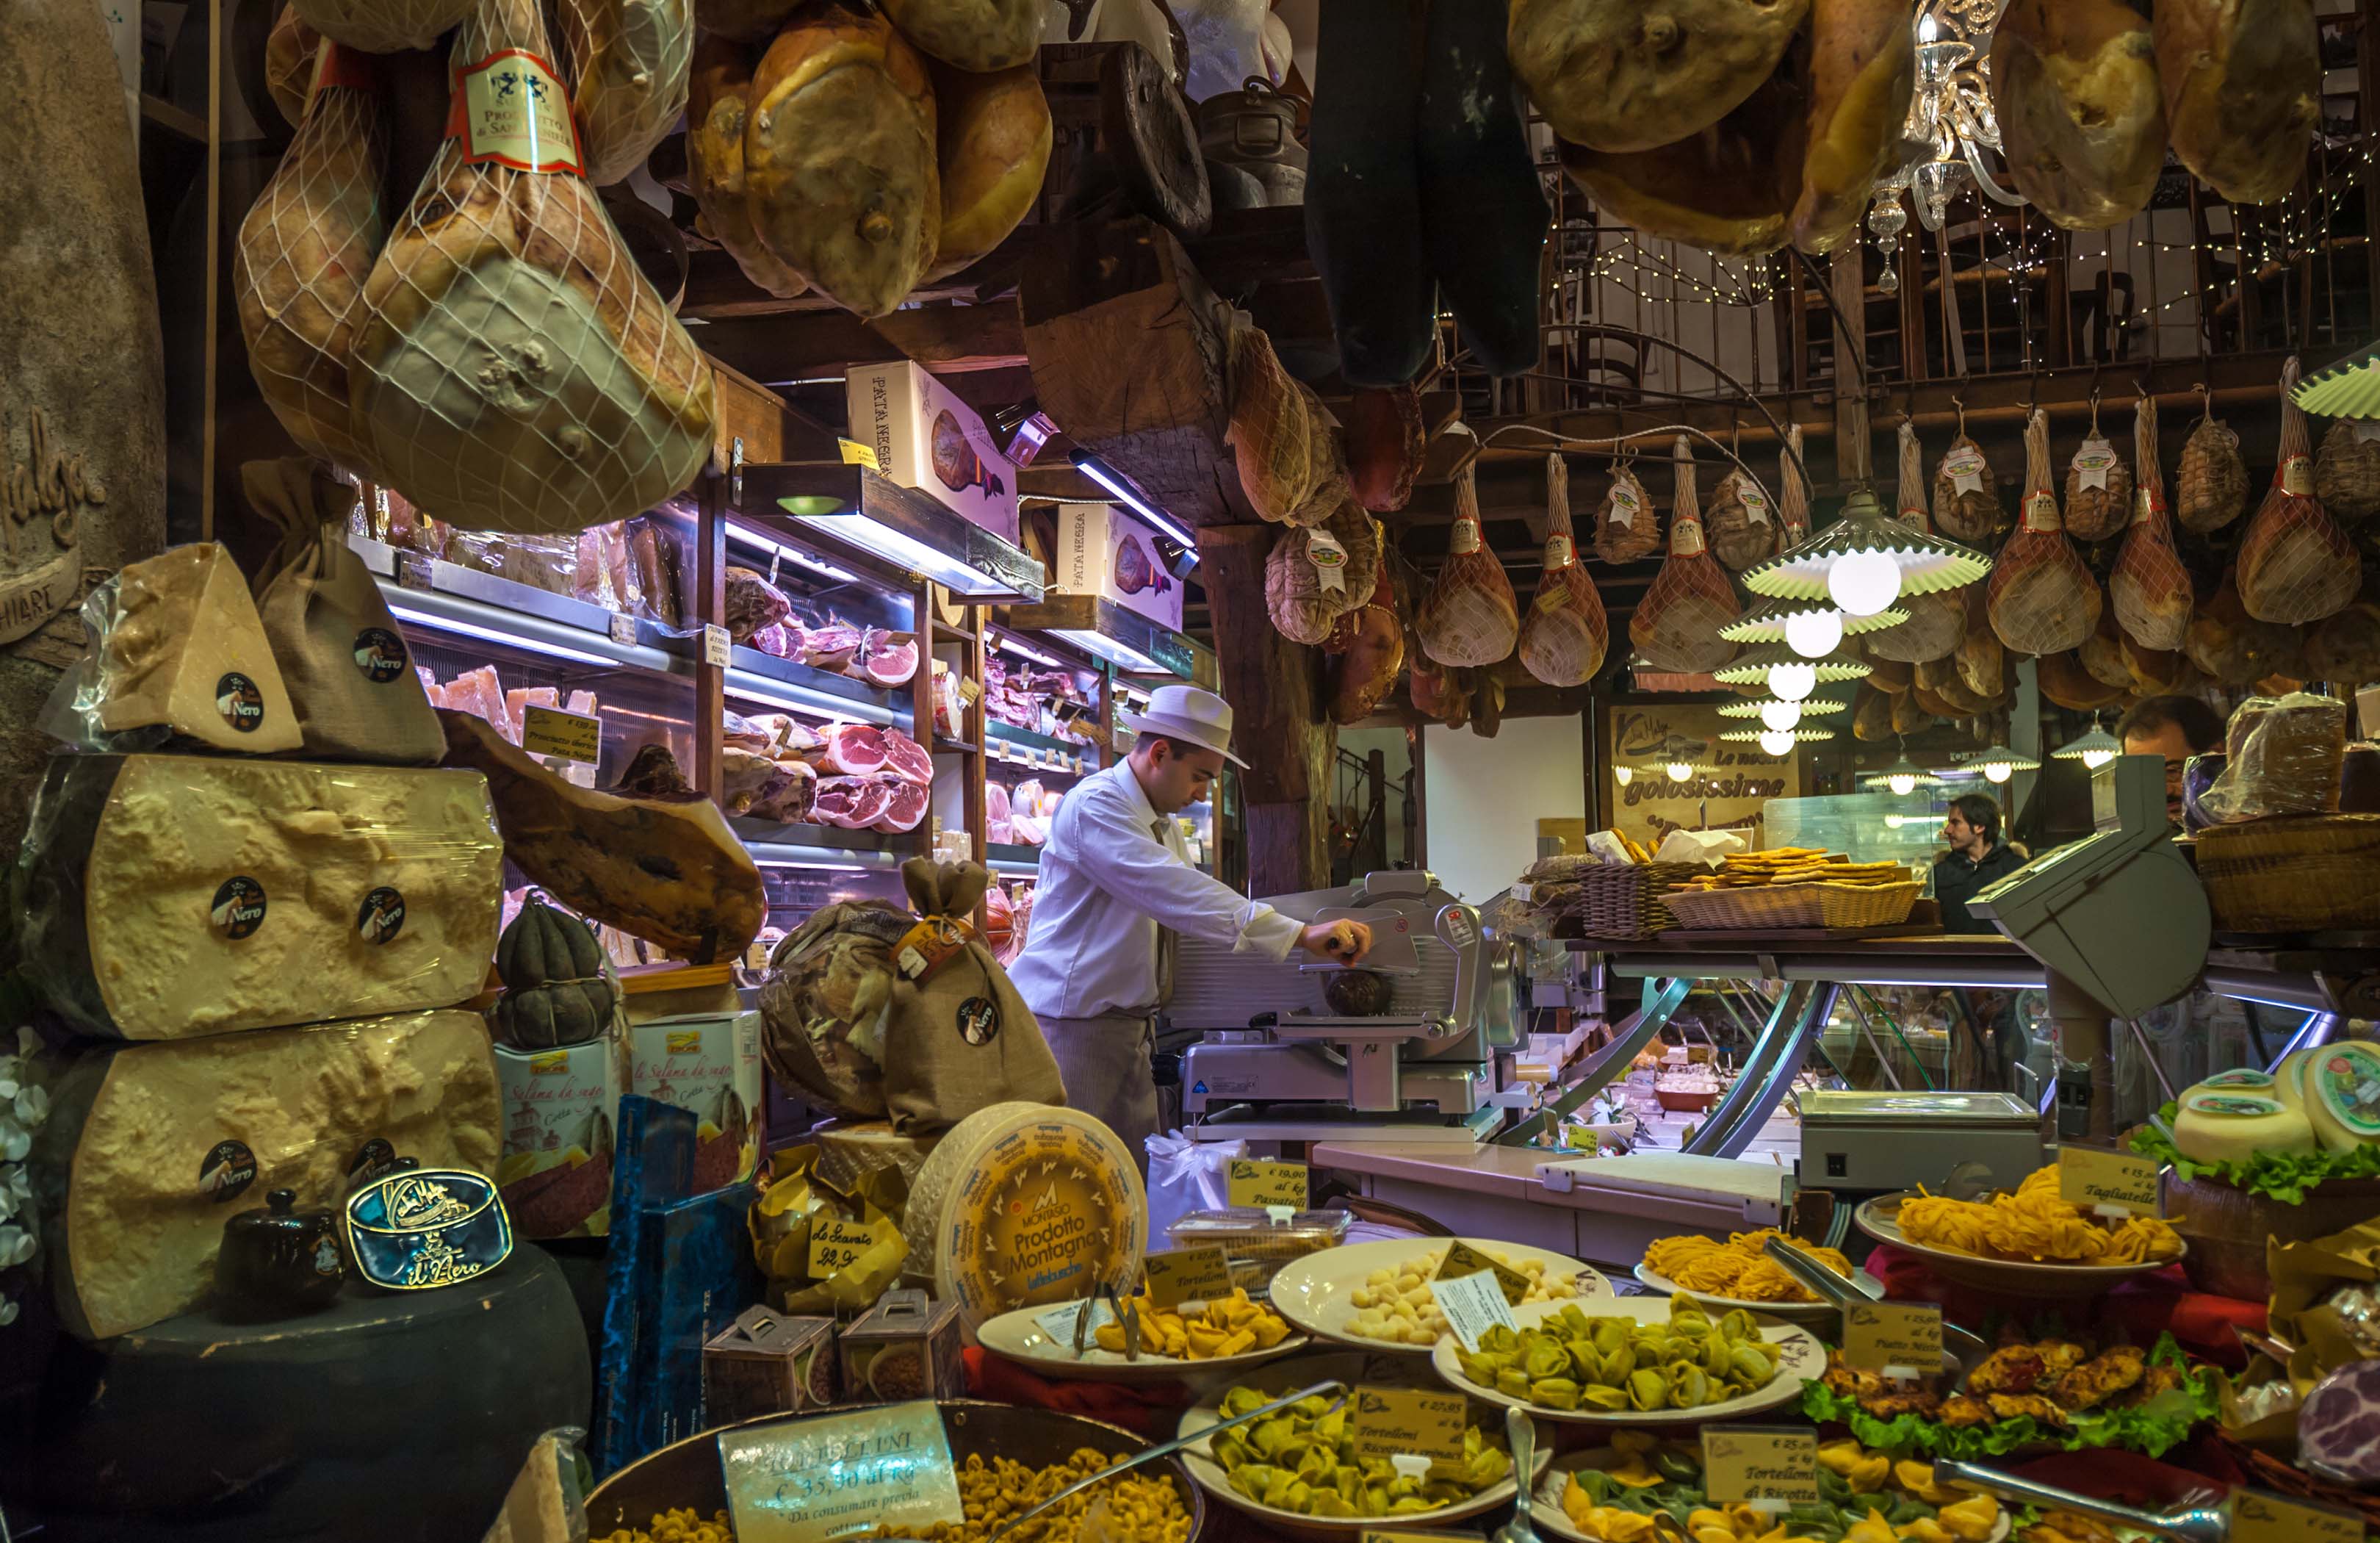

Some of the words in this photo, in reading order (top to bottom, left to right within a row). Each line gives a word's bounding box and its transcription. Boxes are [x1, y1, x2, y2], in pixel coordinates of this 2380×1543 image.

[873, 377, 889, 422] PATA
[1073, 555, 1084, 588] PATA
[370, 655, 401, 669] Nero
[233, 702, 260, 716] Nero
[1714, 749, 1734, 766] Le
[1623, 772, 1786, 807] golosissime
[231, 906, 262, 922] Nero
[375, 907, 403, 928] Nero
[976, 1007, 992, 1033] Nero
[650, 1057, 688, 1079] Salama
[512, 1076, 552, 1101] Salama
[221, 1169, 253, 1187] Nero
[1275, 1181, 1291, 1191] al
[1292, 1182, 1306, 1196] kg
[2085, 1184, 2157, 1204] Tagliatelle
[1252, 1194, 1306, 1207] Passatelli
[1022, 1203, 1071, 1229] MONTASIO
[1014, 1215, 1085, 1253] Prodotto
[1010, 1231, 1097, 1275] Montagna
[1175, 1272, 1227, 1288] Tortelloni
[1359, 1426, 1420, 1441] Tortelloni
[1362, 1442, 1407, 1455] Ricotta
[1745, 1466, 1815, 1481] Tortelloni
[1743, 1485, 1761, 1500] di
[1764, 1486, 1817, 1500] Ricotta
[812, 1497, 879, 1520] consumare
[881, 1489, 920, 1510] previa
